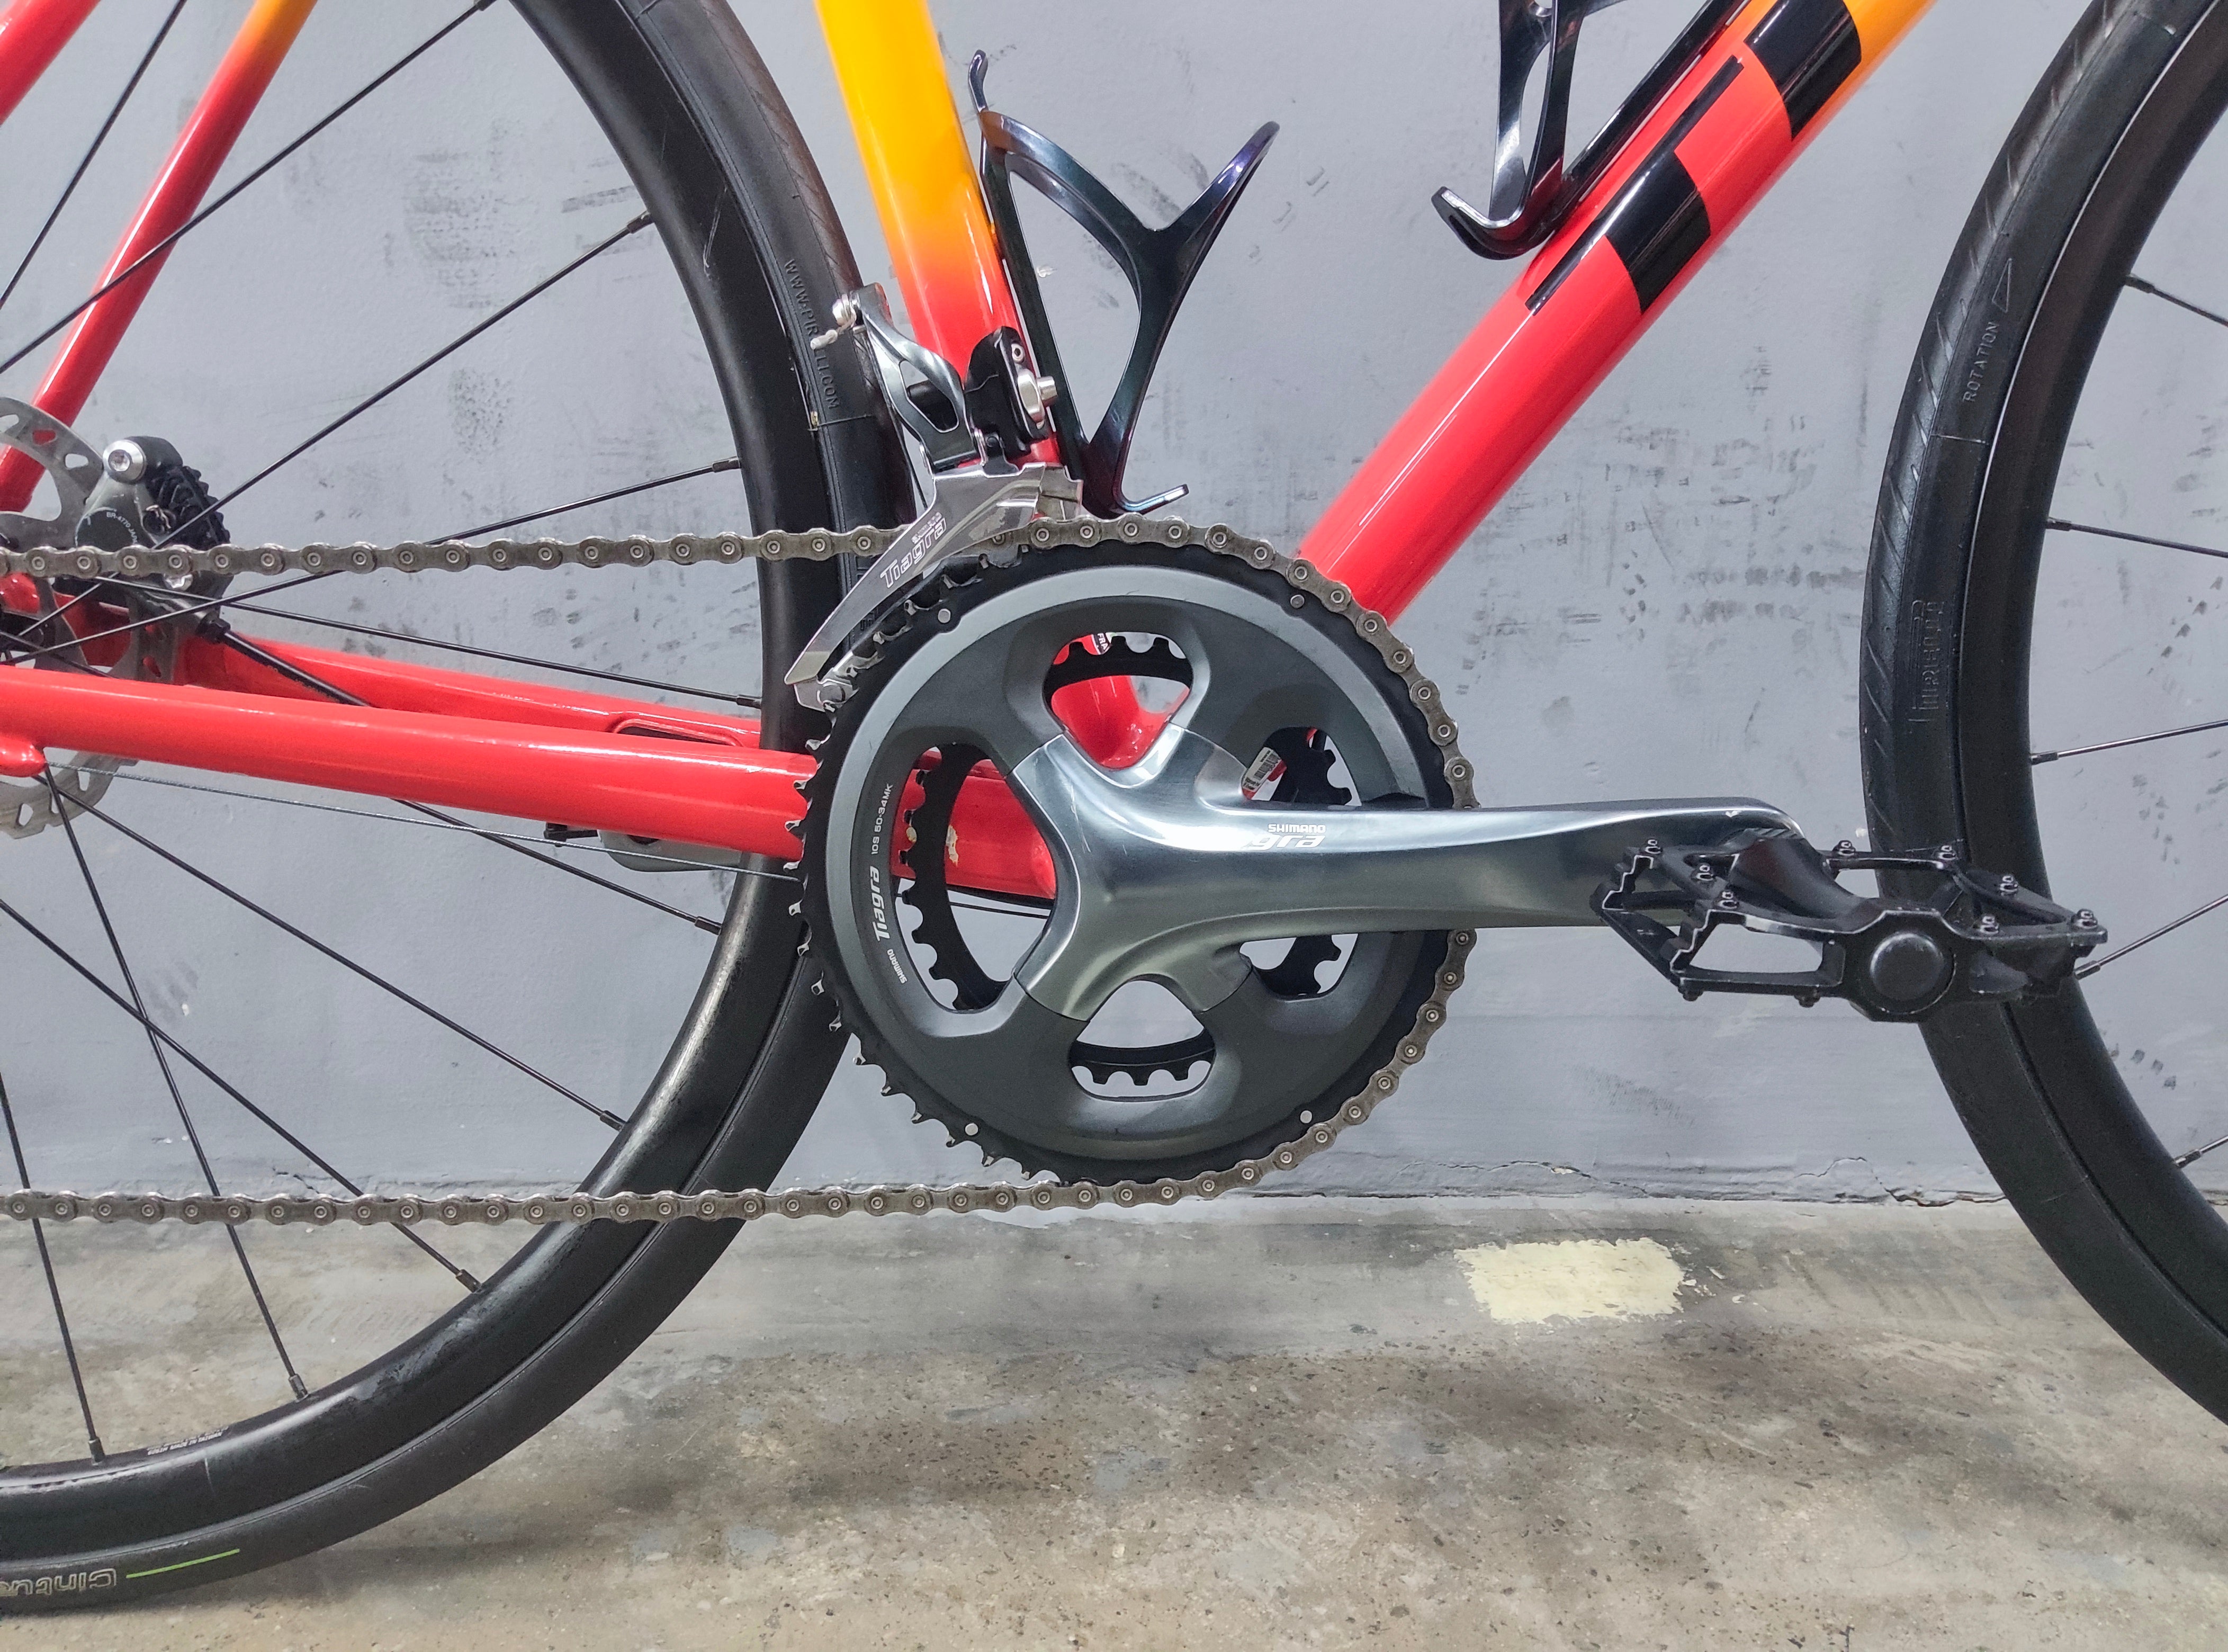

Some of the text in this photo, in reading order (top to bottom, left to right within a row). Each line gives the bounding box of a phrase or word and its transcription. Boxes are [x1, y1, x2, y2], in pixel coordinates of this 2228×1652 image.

[784, 258, 840, 409] WWW.PIRLLI.COM
[1962, 321, 2000, 403] ROTATION
[128, 528, 138, 545] JAPA
[879, 517, 947, 588] Tiagra
[1097, 633, 1109, 651] FRA
[1268, 824, 1326, 833] SHIMANO
[871, 836, 880, 855] 10S
[1247, 835, 1326, 851] gra
[870, 866, 891, 941] Tiagra
[887, 948, 908, 984] SHIMANO
